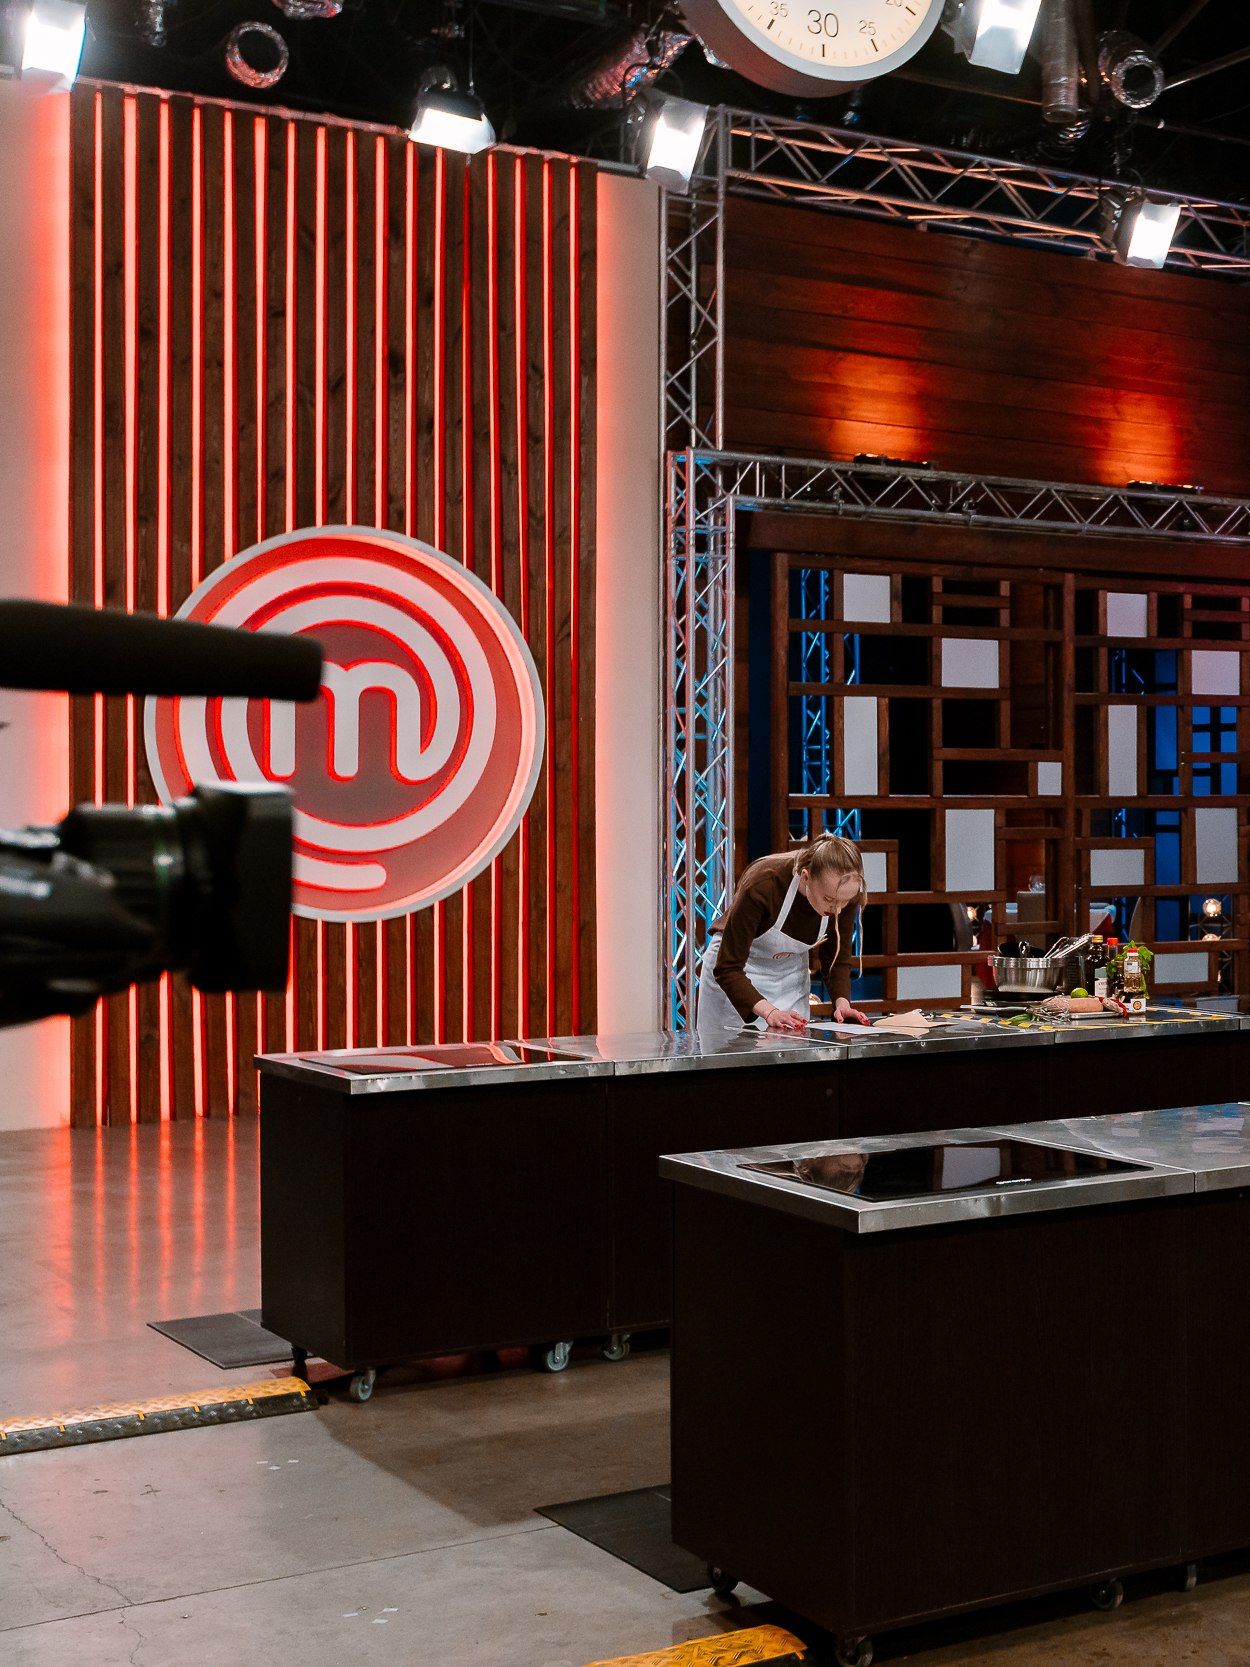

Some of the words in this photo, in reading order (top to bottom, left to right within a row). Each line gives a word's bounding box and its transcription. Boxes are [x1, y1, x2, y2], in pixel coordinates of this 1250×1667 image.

[769, 1, 789, 18] 35
[807, 9, 839, 38] 30
[858, 19, 877, 36] 25
